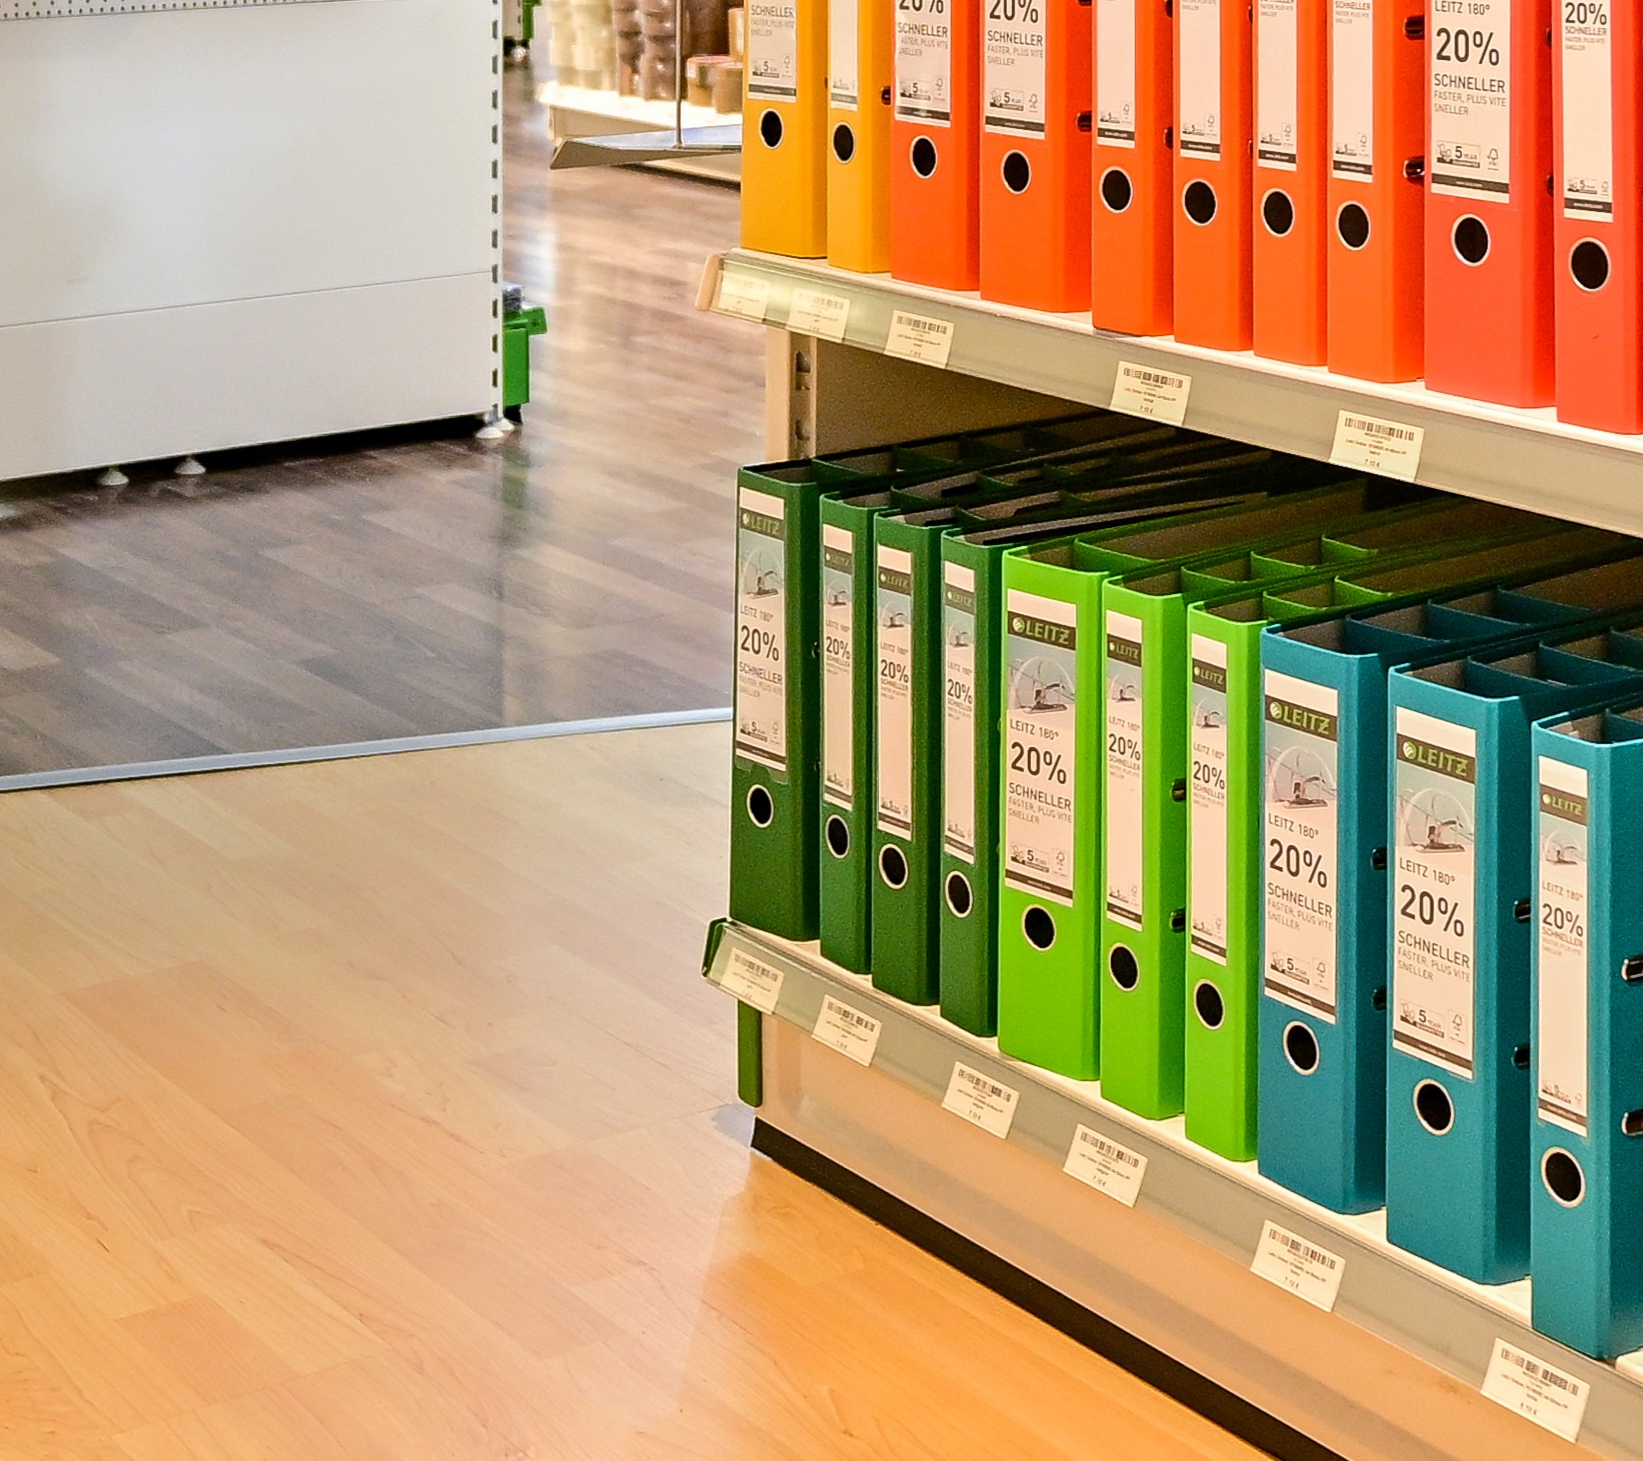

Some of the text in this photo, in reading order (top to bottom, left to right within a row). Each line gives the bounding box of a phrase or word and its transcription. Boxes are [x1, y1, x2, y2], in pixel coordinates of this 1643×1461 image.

[1435, 0, 1462, 14] LEITZ
[1565, 2, 1606, 25] 20%
[898, 22, 947, 37] SCHNELLER
[988, 31, 1043, 46] SCHNELLER
[1436, 28, 1499, 65] 20%
[1434, 74, 1505, 93] SCHNELLER
[1467, 94, 1486, 106] PLUS
[740, 625, 778, 661] 20%
[1026, 620, 1070, 645] LEITZ
[826, 636, 850, 660] 20%
[1116, 644, 1138, 659] LEITZ
[881, 659, 908, 683] 20%
[1201, 669, 1223, 685] LEITZ
[948, 679, 972, 704] 20%
[1284, 706, 1329, 735] LEITZ
[1109, 733, 1140, 761] 20%
[1011, 741, 1066, 785] 20%
[1418, 745, 1467, 777] LEITZ
[1193, 761, 1225, 790] 20%
[1009, 782, 1071, 810] SCHNELLER
[1552, 797, 1582, 816] LEITZ
[1268, 810, 1293, 830] LEITZ
[1270, 837, 1327, 889] 20%
[1400, 855, 1427, 876] LEITZ
[1268, 882, 1332, 917] SCHNELLER
[1401, 883, 1464, 938] 20%
[1543, 903, 1583, 938] 20%
[1398, 930, 1470, 968] SCHNELLER
[1431, 959, 1451, 976] PLUS
